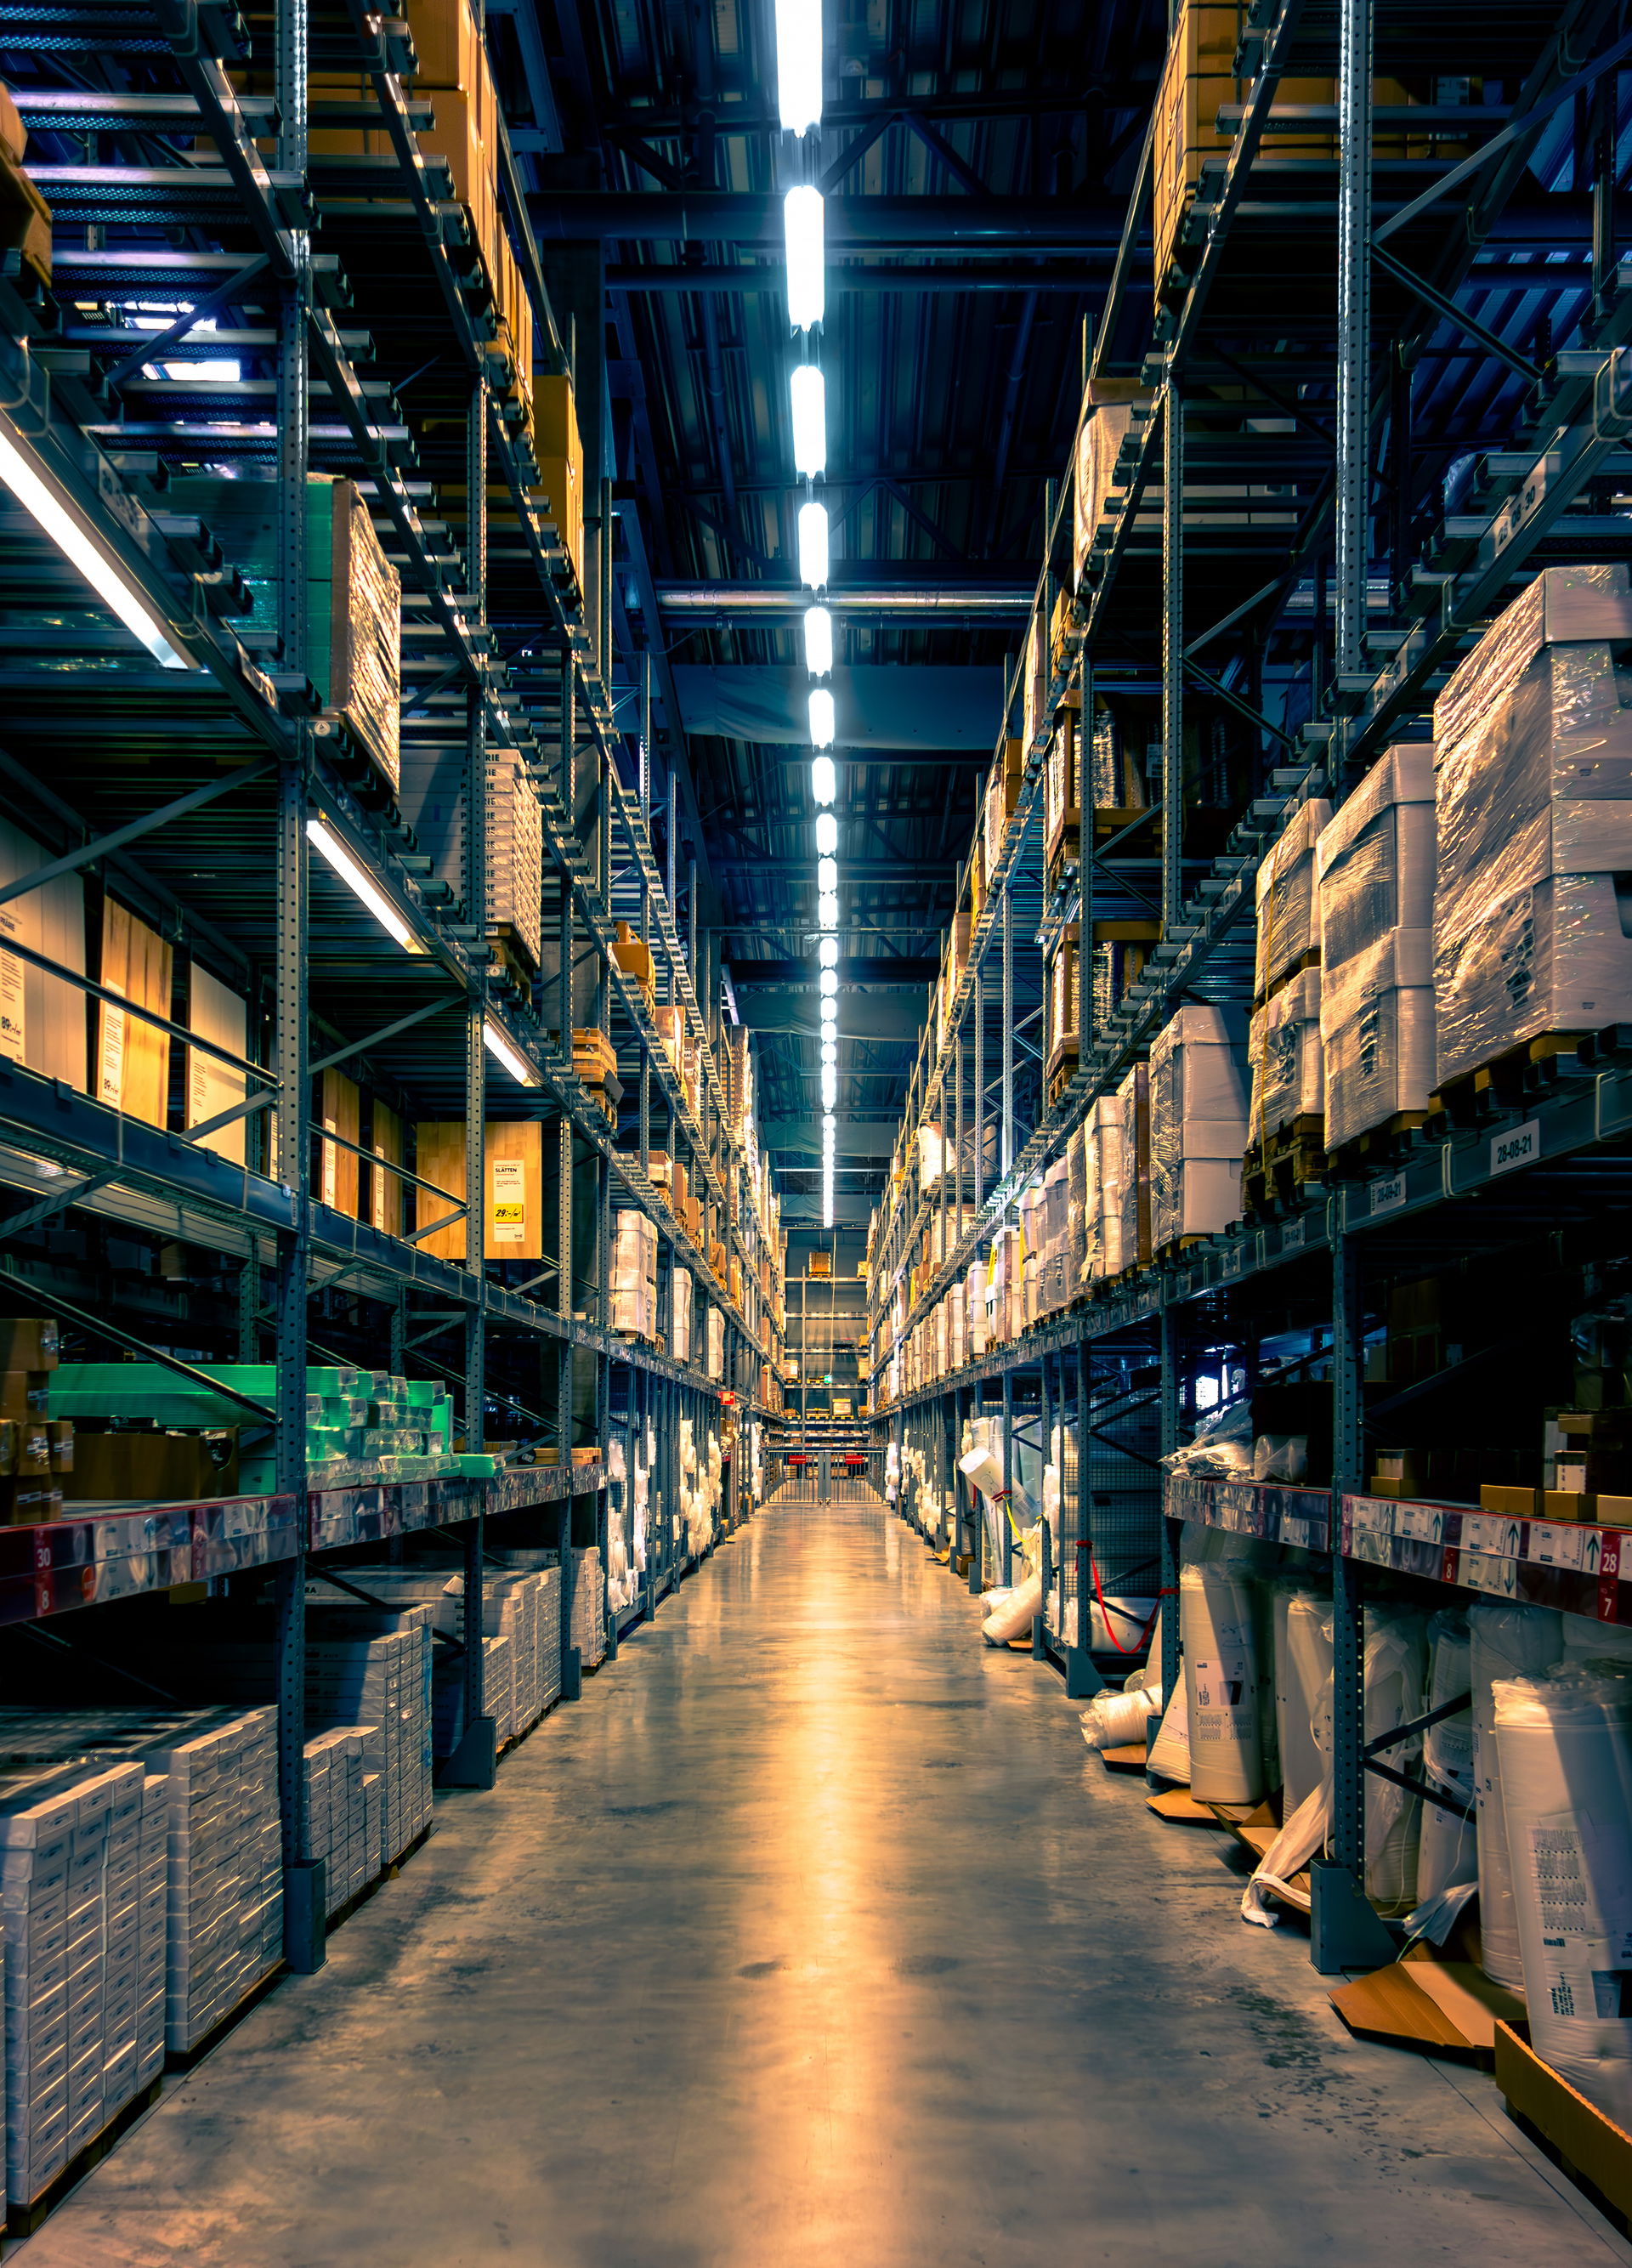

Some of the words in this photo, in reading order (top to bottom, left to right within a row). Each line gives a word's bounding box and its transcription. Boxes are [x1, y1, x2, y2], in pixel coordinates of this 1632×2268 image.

[1497, 1133, 1532, 1165] 28-08-21
[37, 1547, 51, 1568] 30
[1602, 1552, 1618, 1573] 28
[1446, 1563, 1453, 1579] 8
[42, 1590, 49, 1610] 8
[1604, 1597, 1612, 1618] 7
